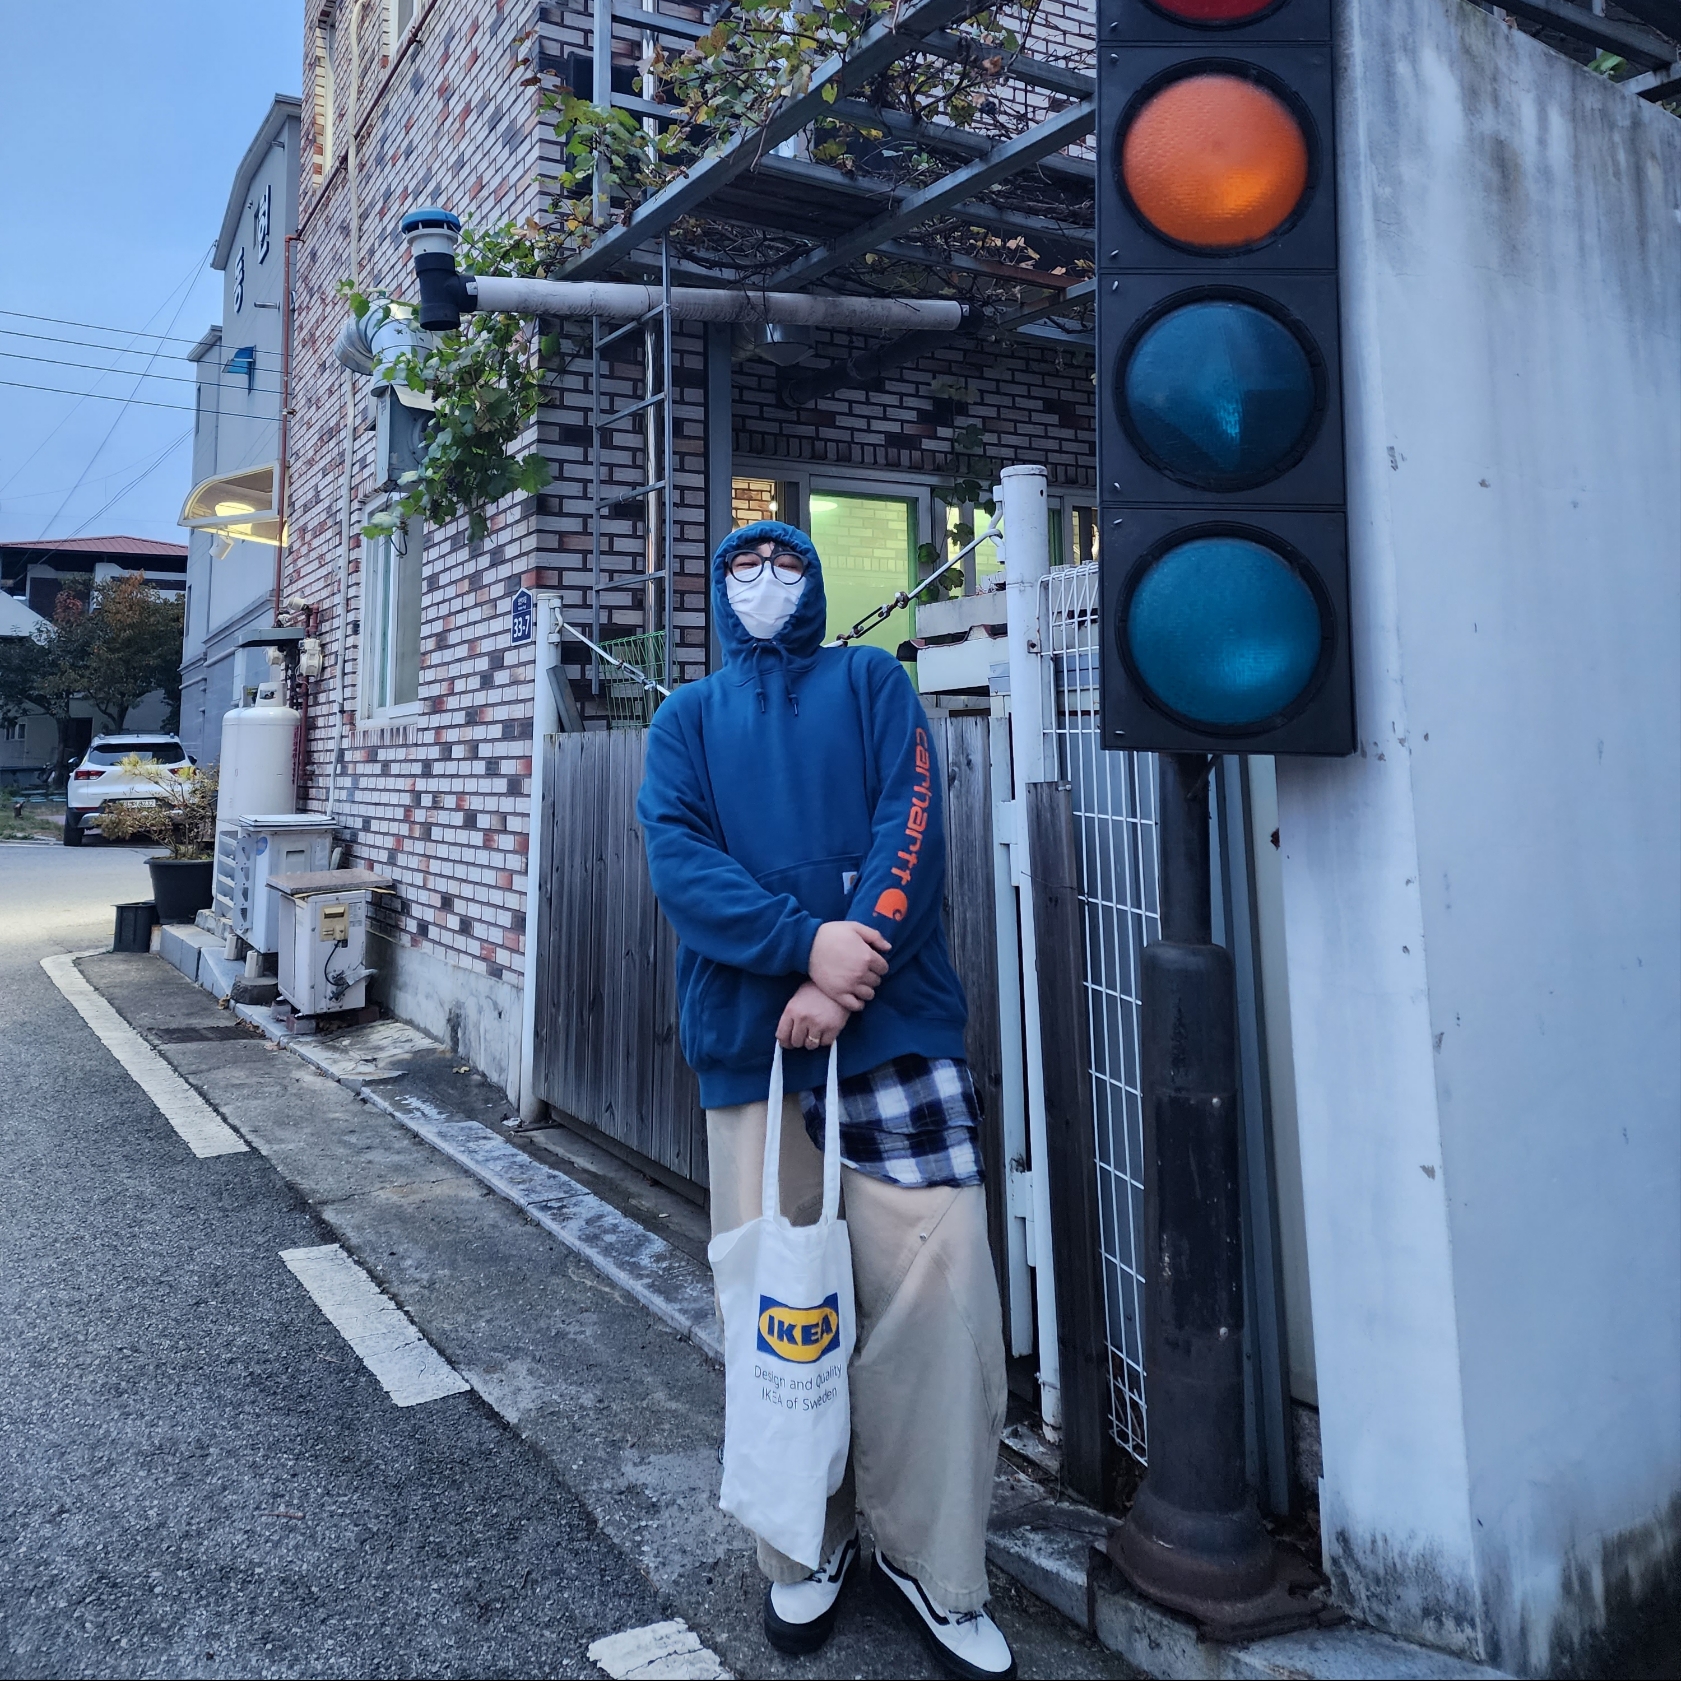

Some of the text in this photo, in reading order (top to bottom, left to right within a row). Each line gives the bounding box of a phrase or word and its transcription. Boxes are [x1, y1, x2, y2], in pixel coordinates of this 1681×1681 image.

[513, 615, 531, 638] 33-7
[890, 727, 933, 886] carhartt
[767, 1314, 833, 1346] IKEA
[754, 1364, 842, 1390] Design and Quality
[761, 1386, 838, 1411] IKEA of Sweden
